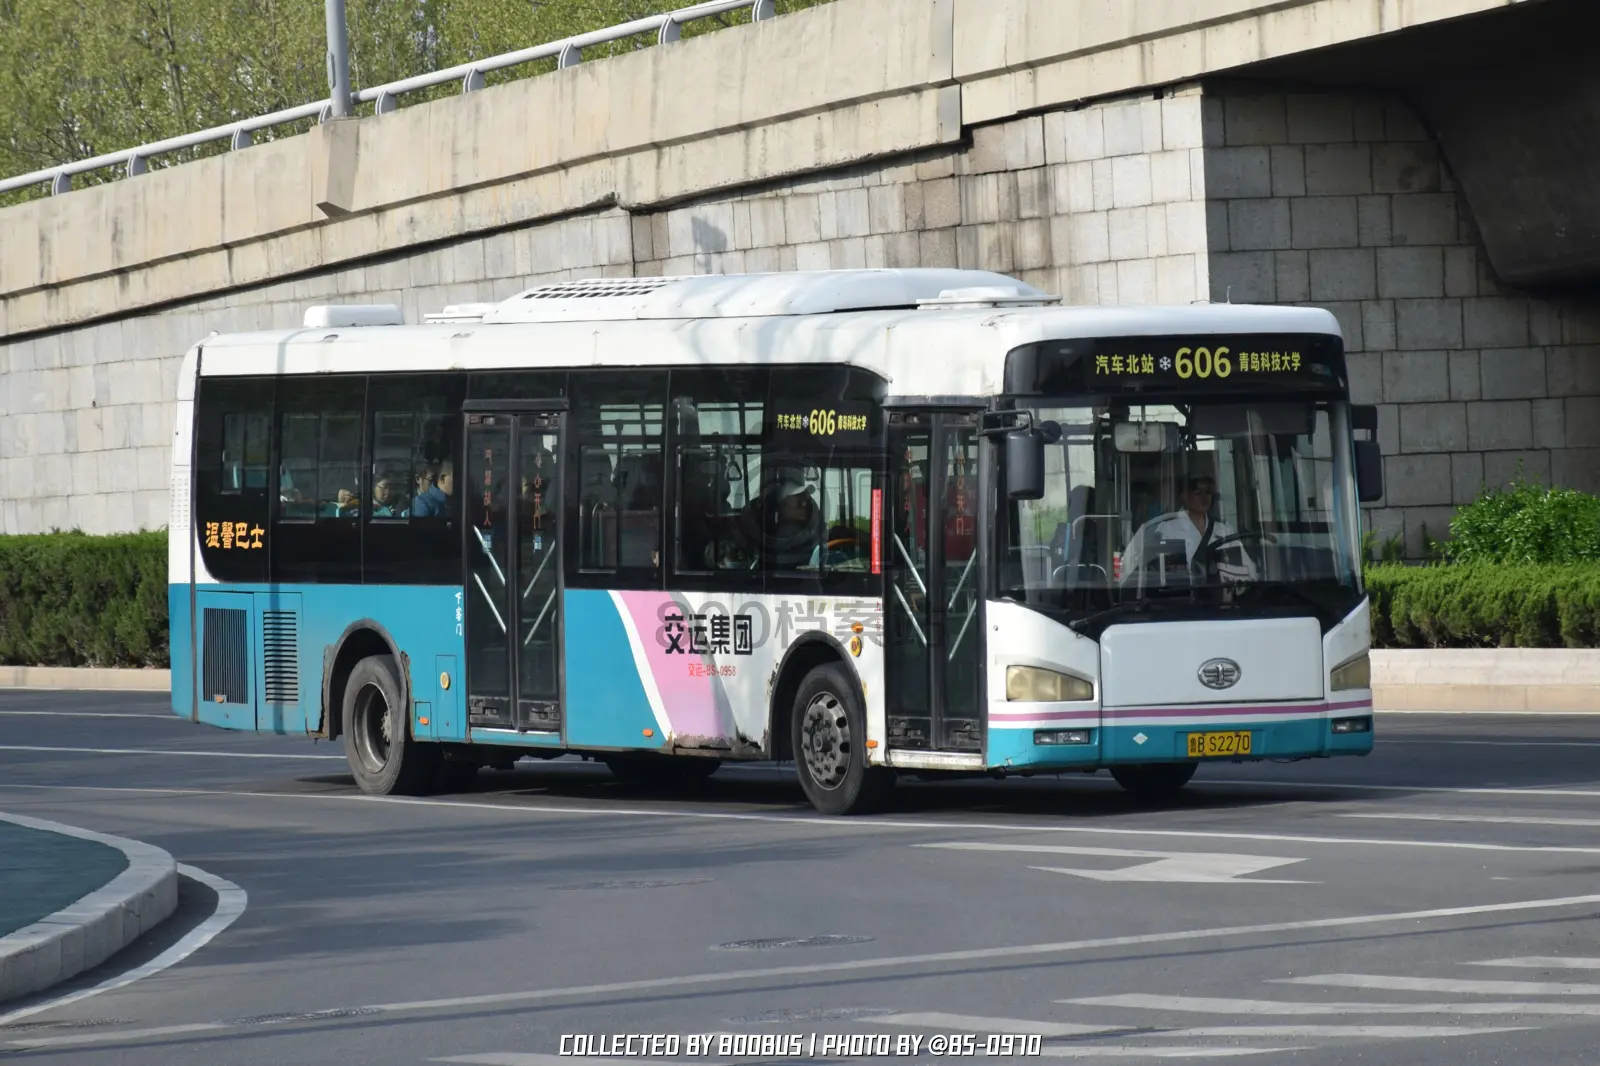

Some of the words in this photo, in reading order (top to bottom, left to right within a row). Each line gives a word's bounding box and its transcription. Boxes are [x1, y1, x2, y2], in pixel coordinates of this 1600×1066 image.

[1096, 354, 1154, 375] 汽车北站
[1175, 346, 1232, 379] 606
[1239, 351, 1301, 372] 青岛科技大学
[809, 409, 836, 435] 606
[205, 521, 265, 549] 温馨巴士
[664, 613, 753, 655] 交运集团
